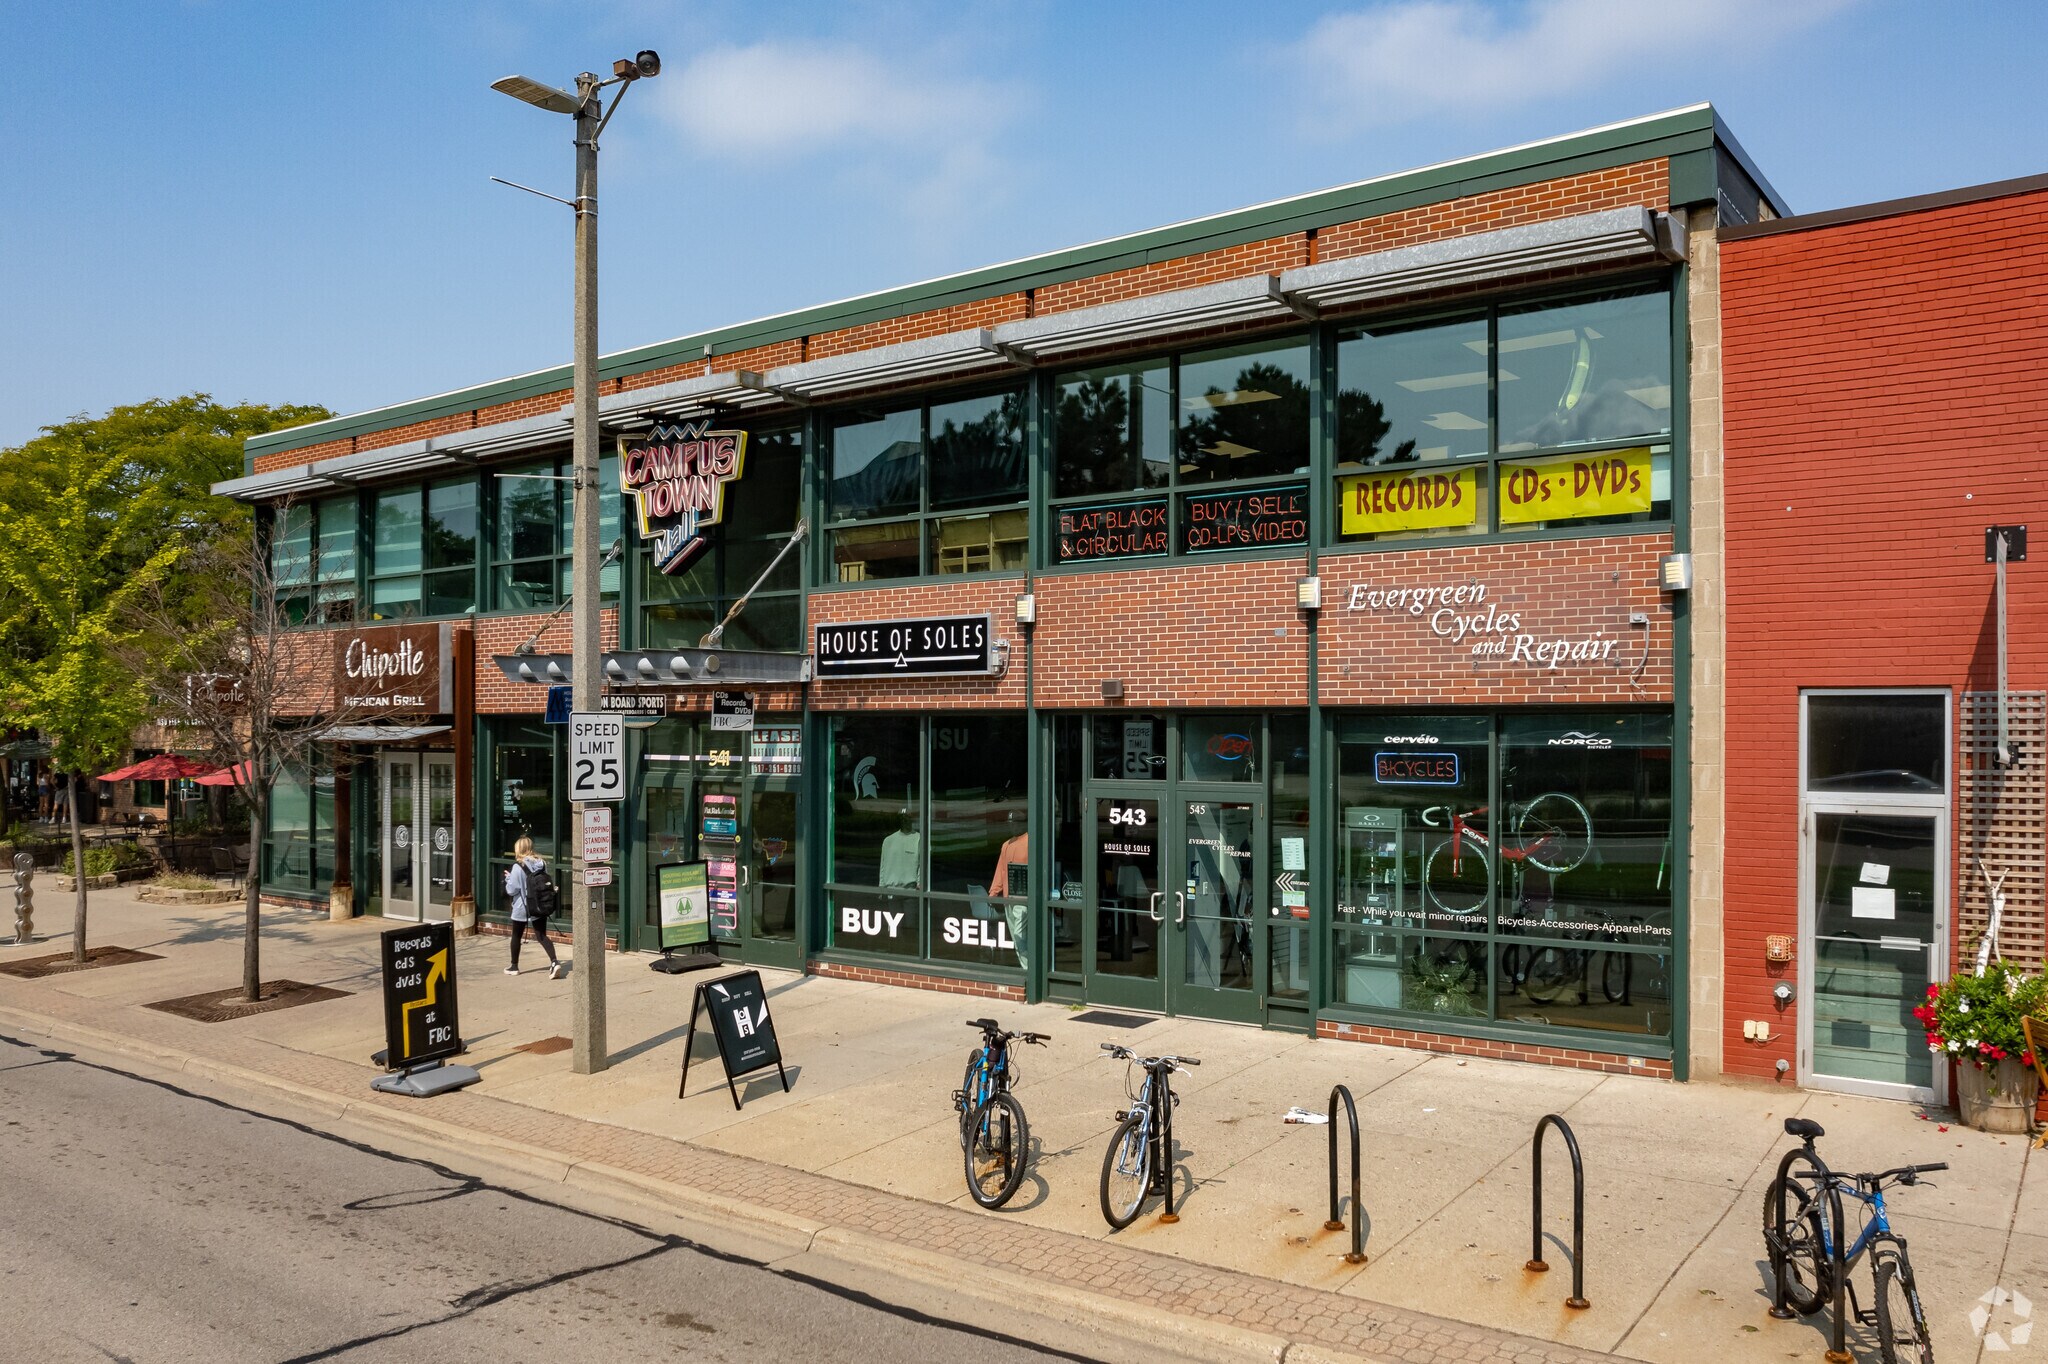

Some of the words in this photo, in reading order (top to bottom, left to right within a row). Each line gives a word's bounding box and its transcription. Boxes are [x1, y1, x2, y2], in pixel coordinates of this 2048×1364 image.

[625, 437, 735, 485] CAMPUS
[1508, 468, 1551, 505] CDs
[1573, 458, 1641, 498] DVDs
[640, 474, 719, 517] TOWN
[1356, 472, 1462, 515] RECORDS
[1191, 500, 1232, 522] BUY
[1248, 496, 1302, 516] SELL
[1060, 512, 1102, 534] FLAT
[1106, 508, 1167, 529] BLACK
[654, 506, 700, 567] Mall
[1251, 520, 1306, 543] VIDEO
[1060, 539, 1073, 558] &
[1076, 532, 1168, 556] CIRCULAR
[1346, 583, 1486, 618] Evergreen
[1430, 604, 1521, 643] Cycles
[820, 629, 879, 655] HOUSE
[890, 628, 912, 651] OF
[923, 624, 983, 651] SOLES
[1471, 635, 1507, 656] and
[1509, 631, 1618, 669] Repair
[345, 638, 424, 689] Chipotle
[344, 695, 390, 707] MEXICAN
[393, 694, 426, 706] GRILL
[610, 696, 636, 708] BOARD
[638, 696, 664, 708] SPORTS
[715, 691, 729, 699] CDs
[721, 699, 747, 707] Records
[575, 723, 620, 737] SPEED
[713, 716, 732, 726] FBC
[753, 730, 800, 742] LEASE
[1384, 733, 1439, 745] cervélo
[1547, 738, 1613, 746] NORCO
[579, 741, 615, 755] LIMIT
[709, 749, 730, 766] 541
[575, 758, 620, 791] 25
[1378, 760, 1456, 778] BICYCLES
[1109, 807, 1147, 826] 543
[1189, 804, 1206, 815] 545
[584, 826, 609, 834] STOPPING
[1461, 827, 1490, 848] cerv
[584, 836, 609, 845] STANDING
[1104, 843, 1122, 851] HOUSE
[1133, 844, 1151, 853] SOLES
[1188, 838, 1222, 846] EVERGREEN
[585, 846, 608, 855] PARKING
[1063, 889, 1083, 898] CLOSE
[842, 907, 905, 938] BUY
[1337, 904, 1356, 914] Fast
[1363, 906, 1388, 916] While
[1389, 910, 1406, 919] you
[1407, 911, 1426, 920] wait
[1428, 912, 1455, 922] minor
[1455, 914, 1488, 925] repairs
[943, 916, 1014, 949] SELL
[394, 936, 432, 953] Records
[425, 1010, 436, 1024] at
[429, 1026, 451, 1046] FBC
